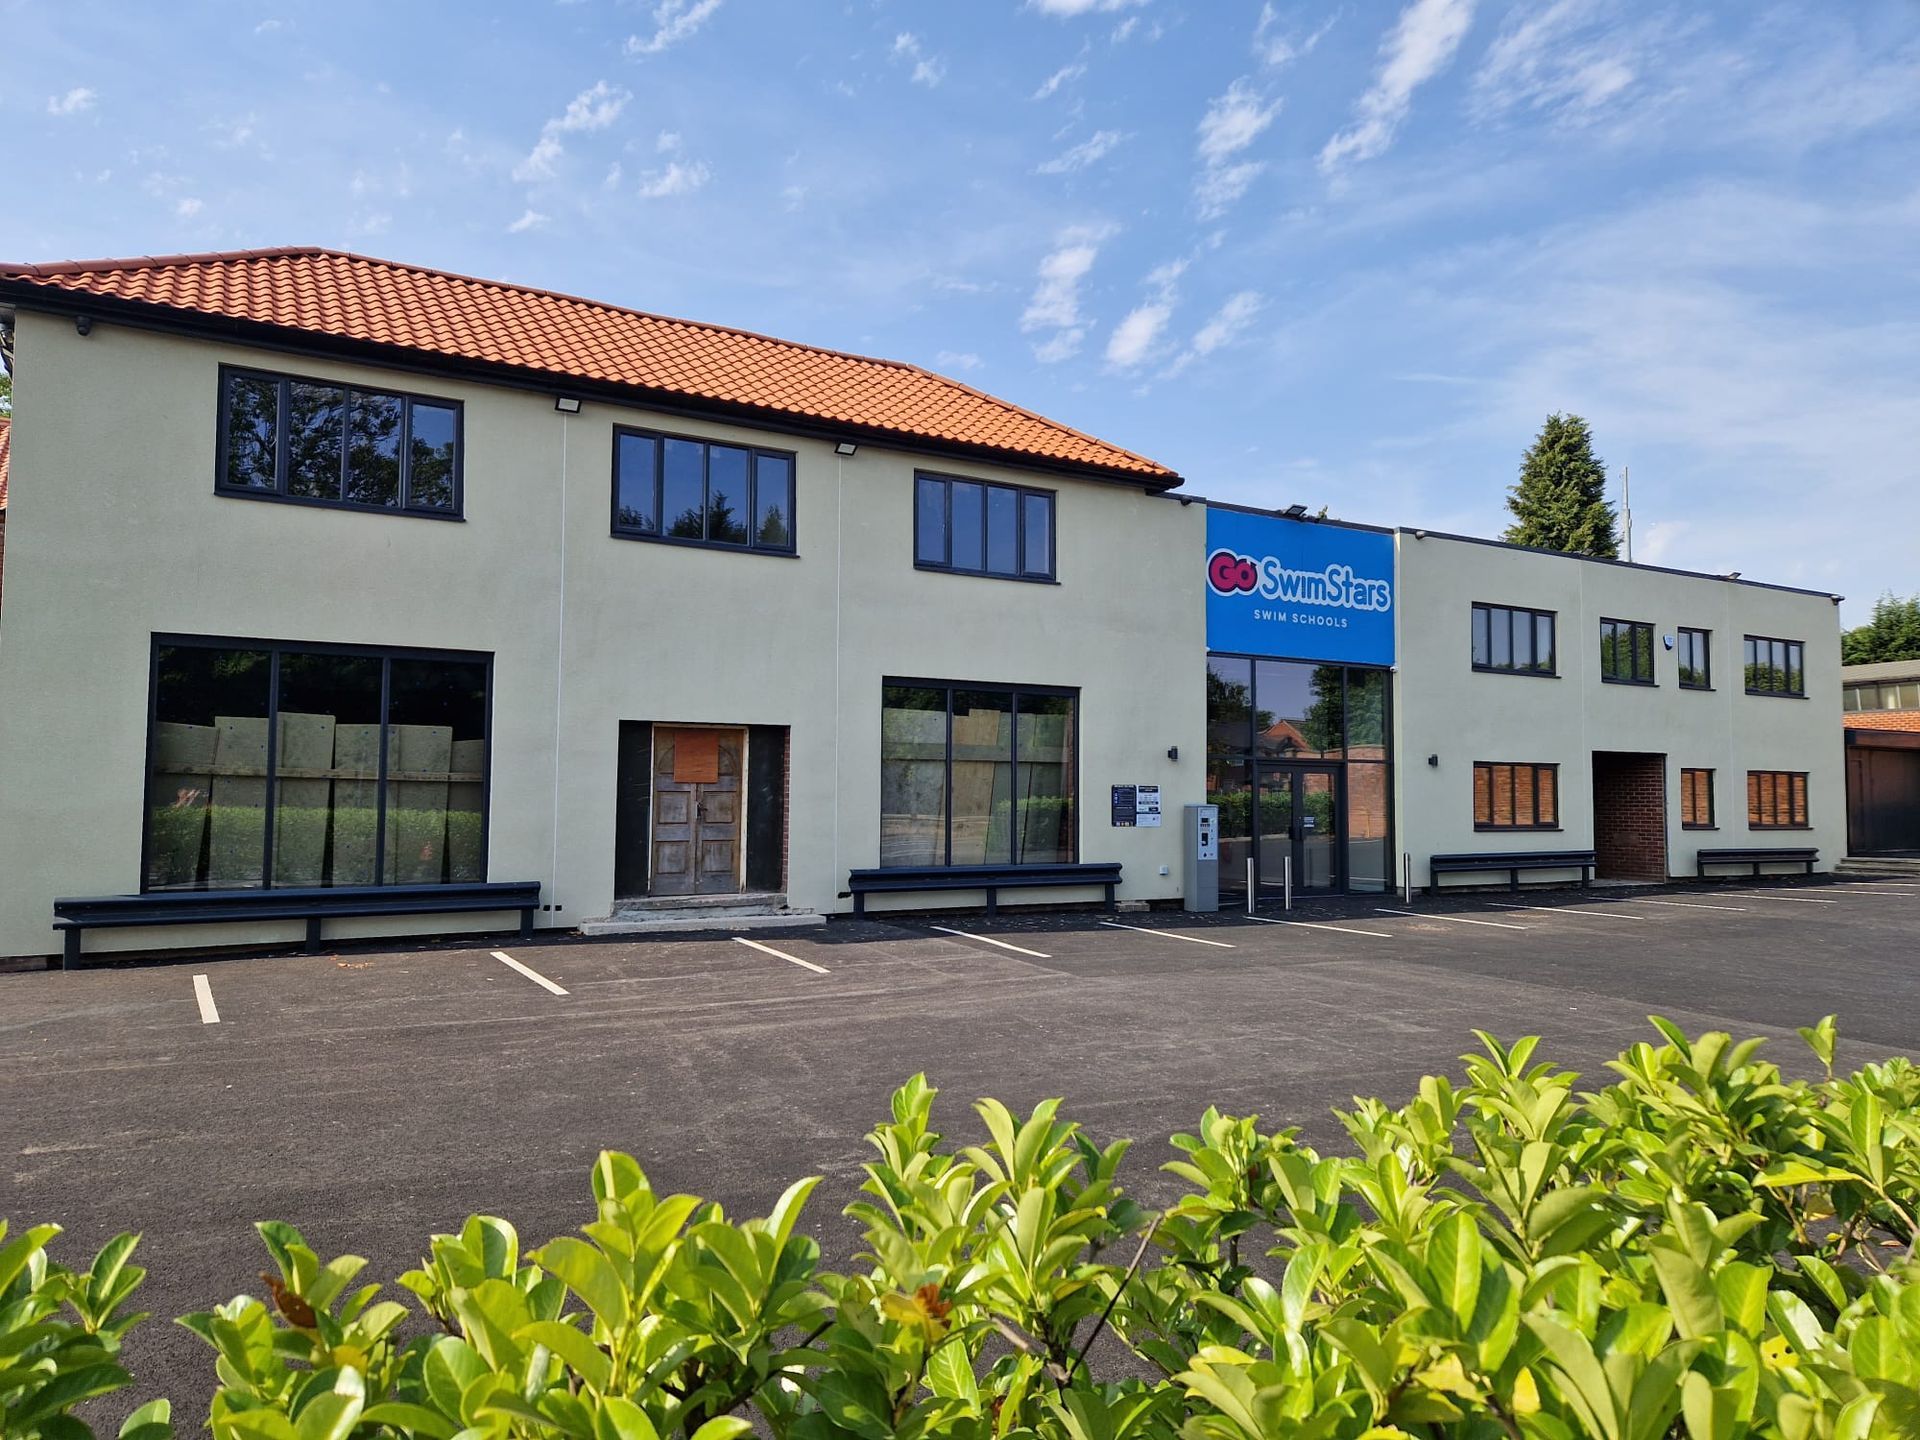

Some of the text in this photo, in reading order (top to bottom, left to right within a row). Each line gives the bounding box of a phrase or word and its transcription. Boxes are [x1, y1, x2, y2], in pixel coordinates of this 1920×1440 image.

[1262, 560, 1388, 607] SwimStars
[1254, 610, 1348, 628] SWIM SCHOOLS
